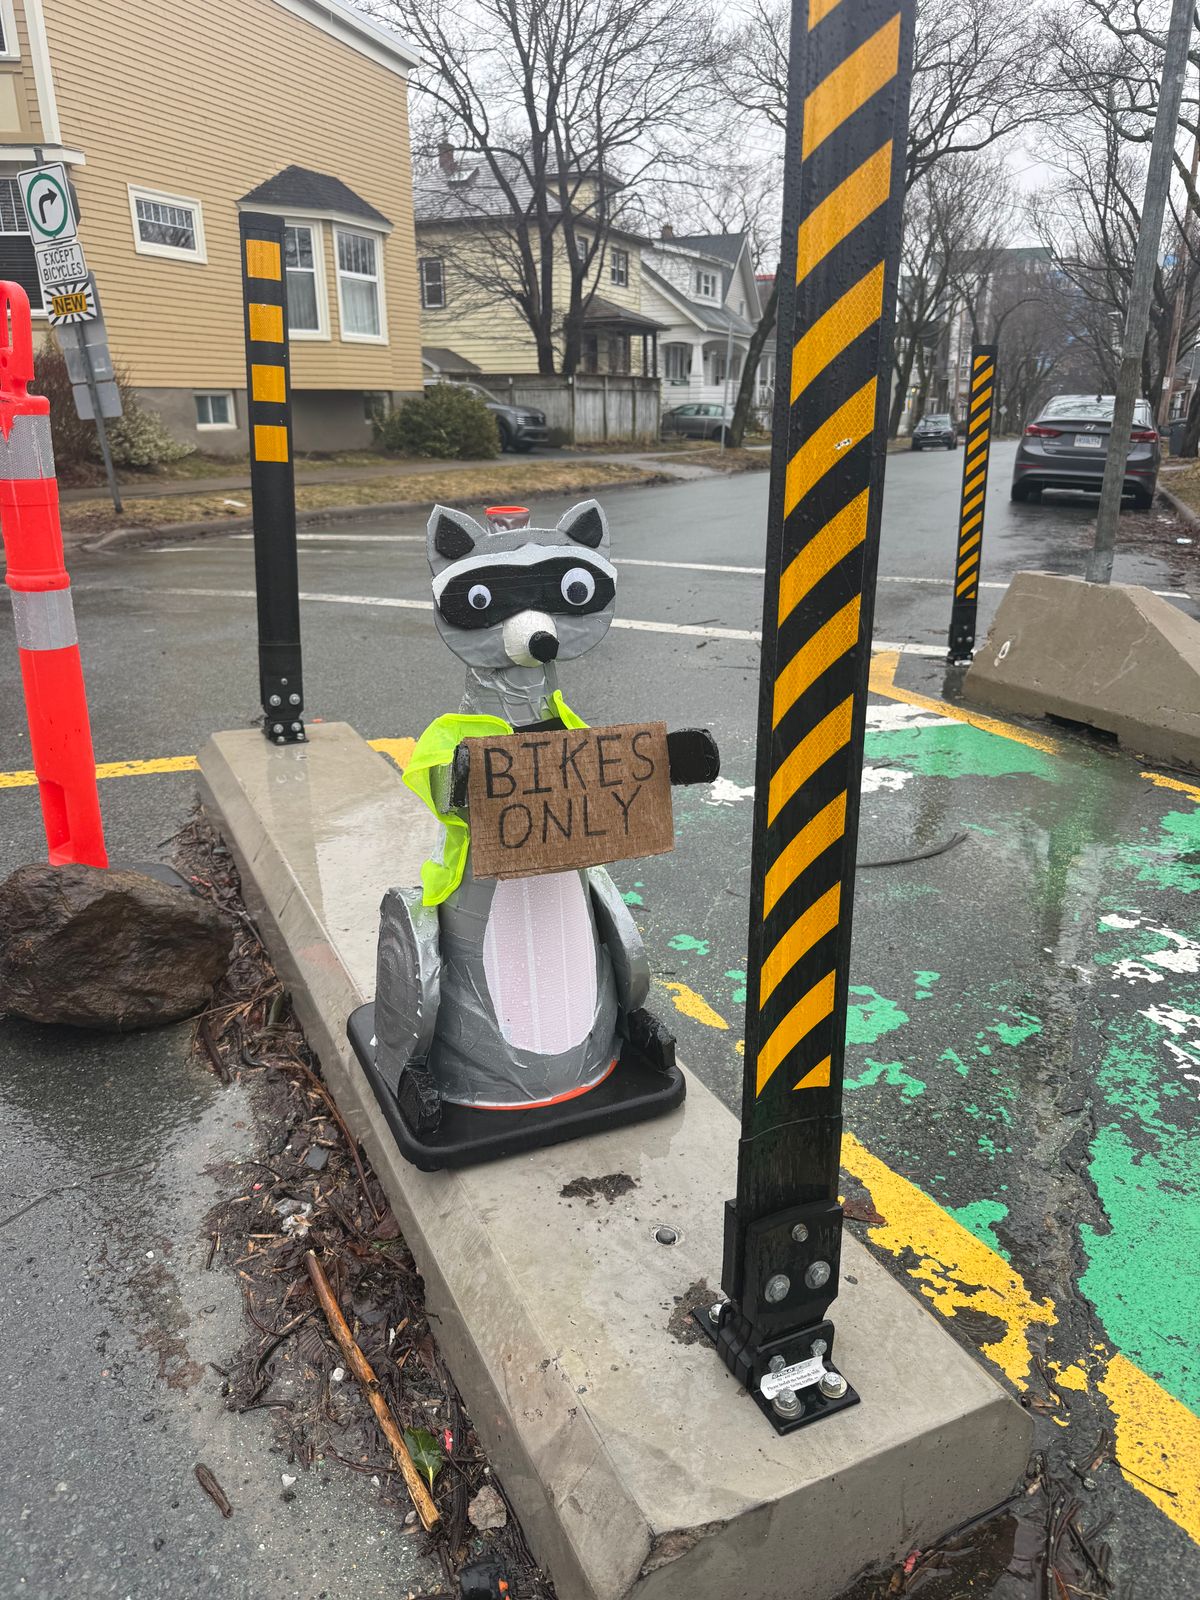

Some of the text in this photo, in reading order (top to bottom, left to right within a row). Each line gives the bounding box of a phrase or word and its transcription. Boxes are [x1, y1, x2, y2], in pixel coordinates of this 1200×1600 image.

[44, 248, 75, 266] EXCEPT
[43, 262, 83, 281] BICYCLES
[54, 294, 85, 314] NEW
[484, 731, 655, 799] BIKES
[498, 785, 642, 849] ONLY
